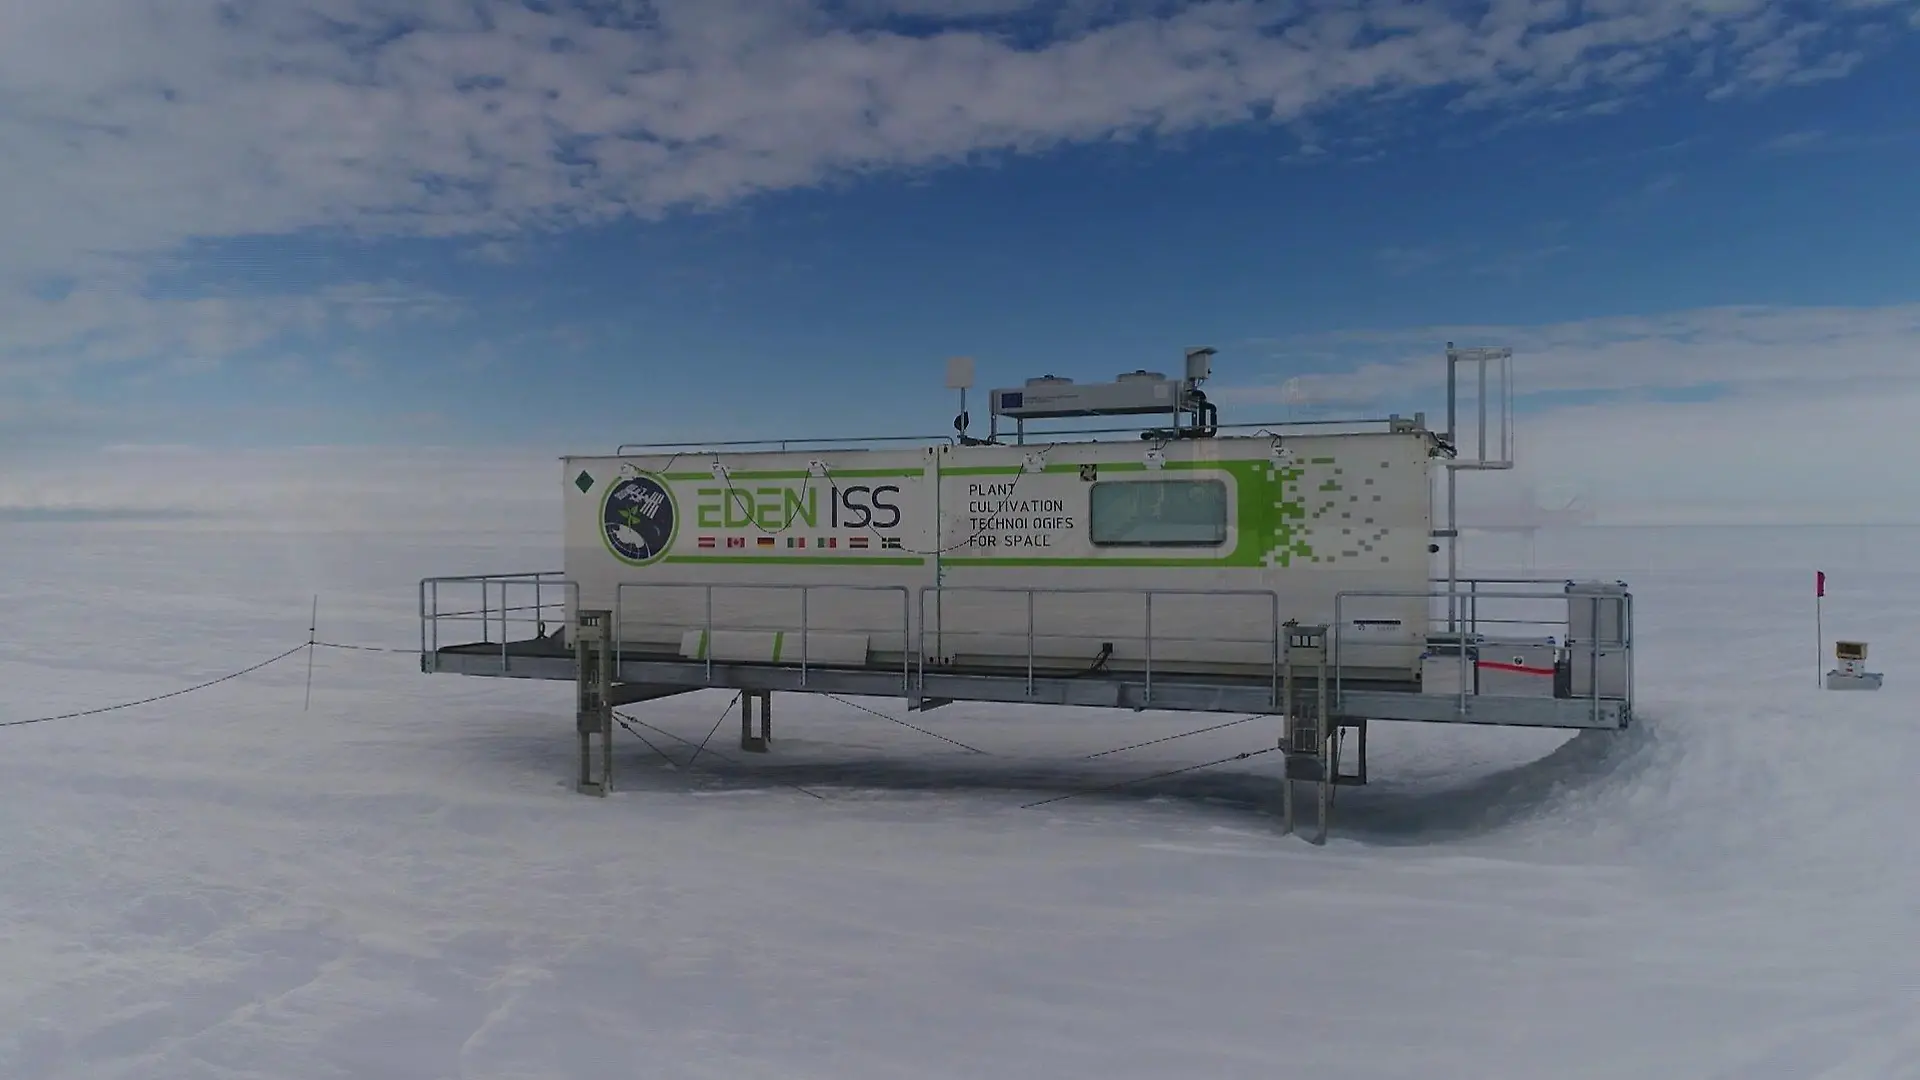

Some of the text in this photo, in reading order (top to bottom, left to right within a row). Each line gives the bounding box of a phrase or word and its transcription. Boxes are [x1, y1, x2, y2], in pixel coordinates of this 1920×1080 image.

[969, 484, 1015, 496] PLANT
[697, 485, 901, 528] EDEN ISS
[969, 500, 1063, 512] CULTIVATION
[970, 517, 1074, 530] TECHNOLOGIES
[970, 535, 1051, 547] FOR SPACE
